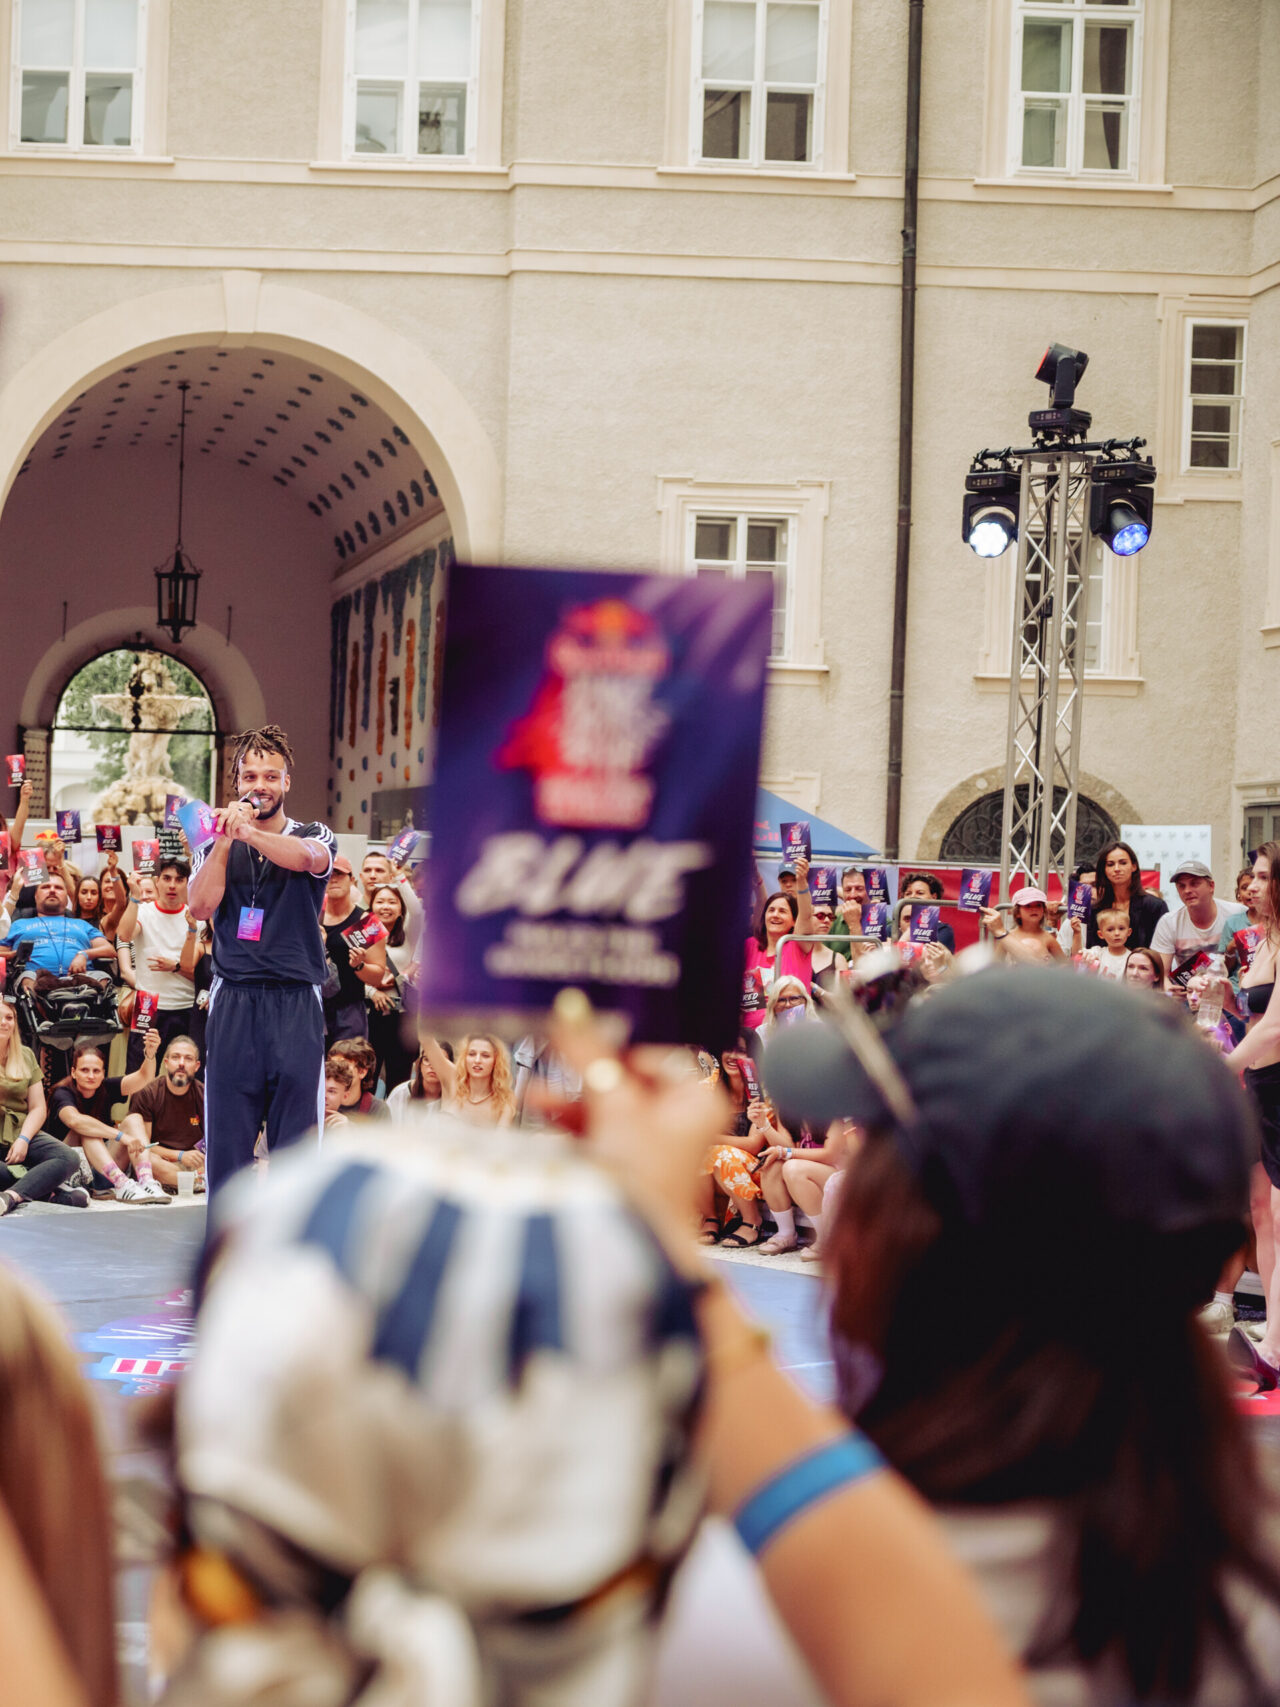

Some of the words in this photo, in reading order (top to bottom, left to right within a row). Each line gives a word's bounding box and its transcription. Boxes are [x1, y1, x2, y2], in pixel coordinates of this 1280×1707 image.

[786, 845, 807, 853] BLUE
[456, 831, 713, 923] BLUE
[812, 889, 833, 897] BLUE
[963, 893, 984, 901] BLUE
[865, 926, 882, 934] BLUE
